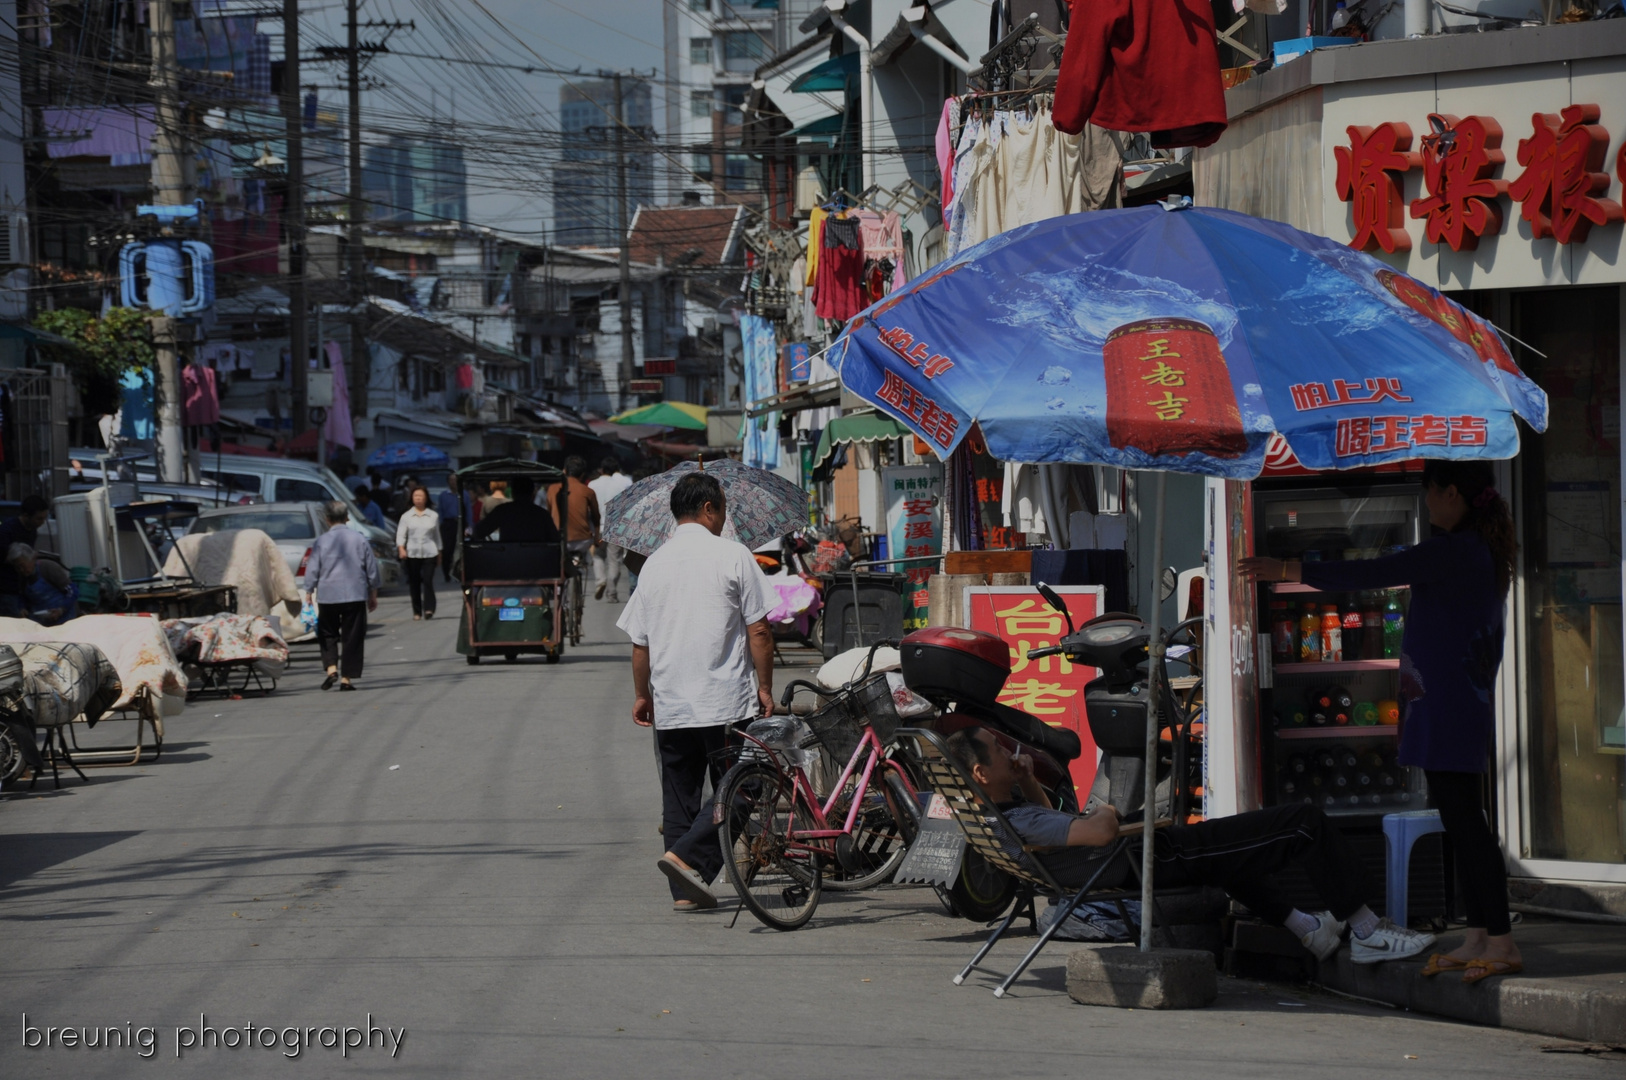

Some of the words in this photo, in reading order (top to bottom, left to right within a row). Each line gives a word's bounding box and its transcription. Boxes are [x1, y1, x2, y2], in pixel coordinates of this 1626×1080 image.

[1334, 104, 1626, 254] 贤梁粮
[874, 367, 959, 449] 喝王老吉
[1138, 338, 1189, 421] 王老吉
[1289, 377, 1413, 411] 怕上火
[1335, 413, 1488, 458] 喝王老吉
[894, 476, 941, 490] 闽南特产
[908, 491, 926, 499] Tea
[903, 499, 936, 608] 安溪铁观音
[995, 599, 1078, 726] 台州老
